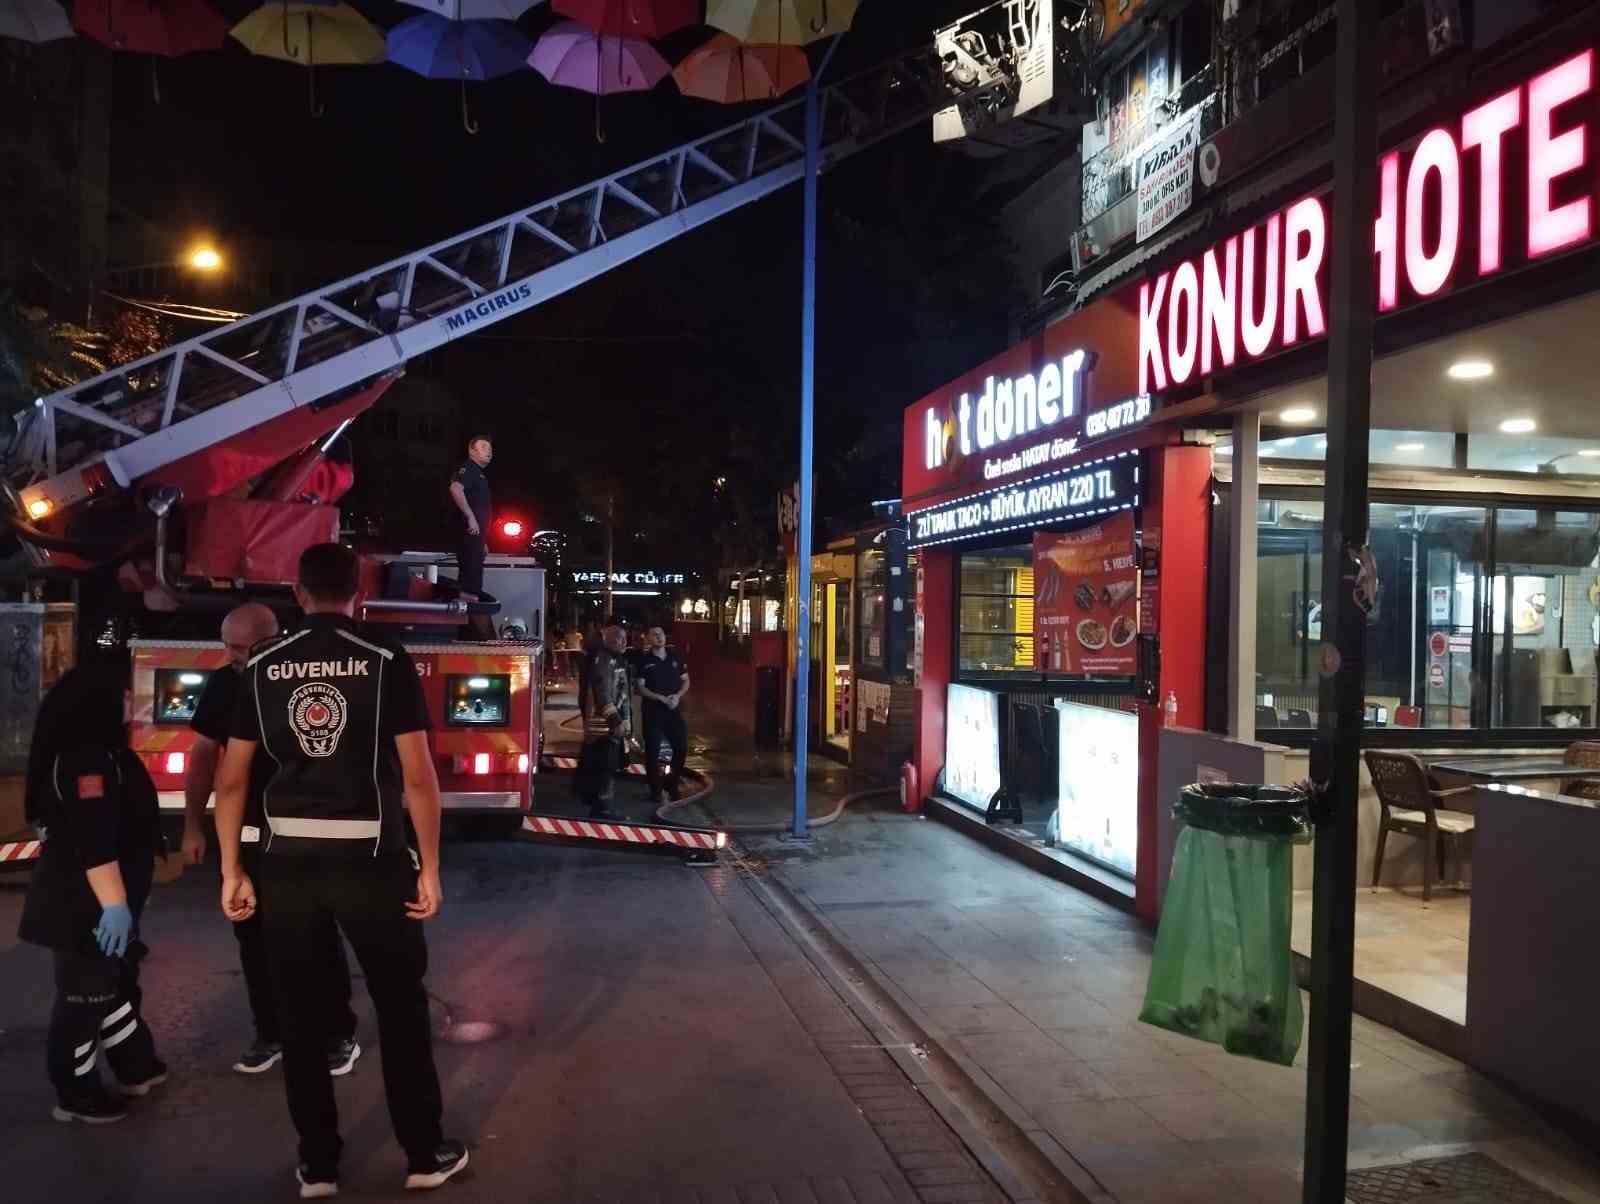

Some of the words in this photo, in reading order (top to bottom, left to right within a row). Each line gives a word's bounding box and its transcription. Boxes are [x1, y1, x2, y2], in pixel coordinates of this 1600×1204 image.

[446, 284, 531, 330] MAGIRUS
[1138, 197, 1326, 394] KONUR
[957, 502, 981, 528] TACO
[990, 489, 1026, 522] BÜYÜK
[1026, 479, 1068, 513] AYRAN
[1069, 473, 1093, 505] 220
[1094, 469, 1115, 499] TL
[266, 656, 369, 681] GÜVENLİK
